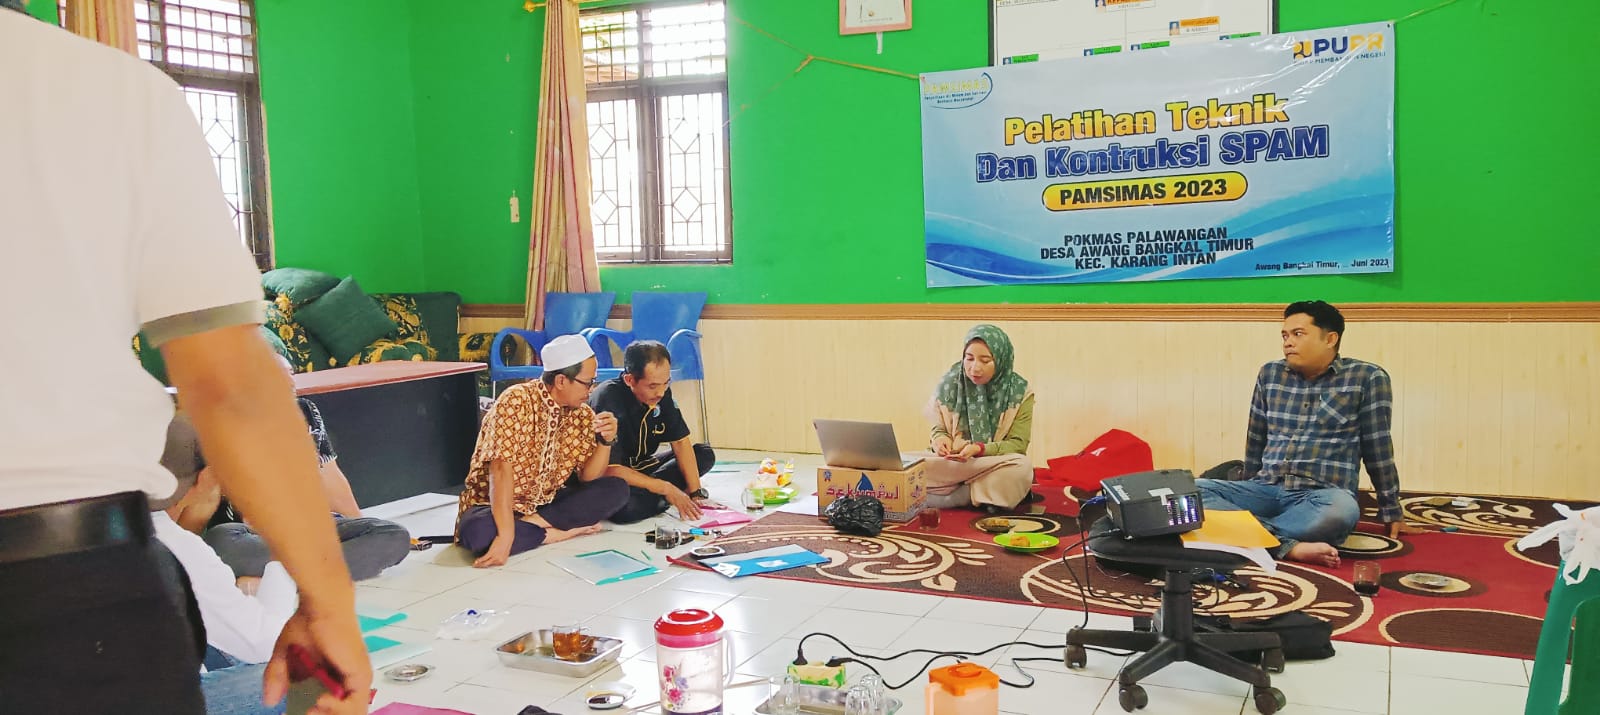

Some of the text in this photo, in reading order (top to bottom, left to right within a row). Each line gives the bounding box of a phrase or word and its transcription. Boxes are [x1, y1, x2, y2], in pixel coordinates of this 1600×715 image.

[1314, 32, 1384, 56] PUPR
[1004, 93, 1290, 146] Pelatihan Teknik
[976, 124, 1330, 183] Dan Kontruksi SPAM
[1060, 179, 1227, 205] PAMSIMAS 2023
[1064, 227, 1228, 246] POKMAS PALAWANGAN
[1040, 237, 1255, 260] DESA AWANG BANGKAL TIMUR
[1075, 252, 1217, 270] KEC. KARANG INTAN
[1255, 263, 1281, 271] Awang
[1316, 260, 1340, 269] Timur,
[1351, 258, 1368, 268] Juni
